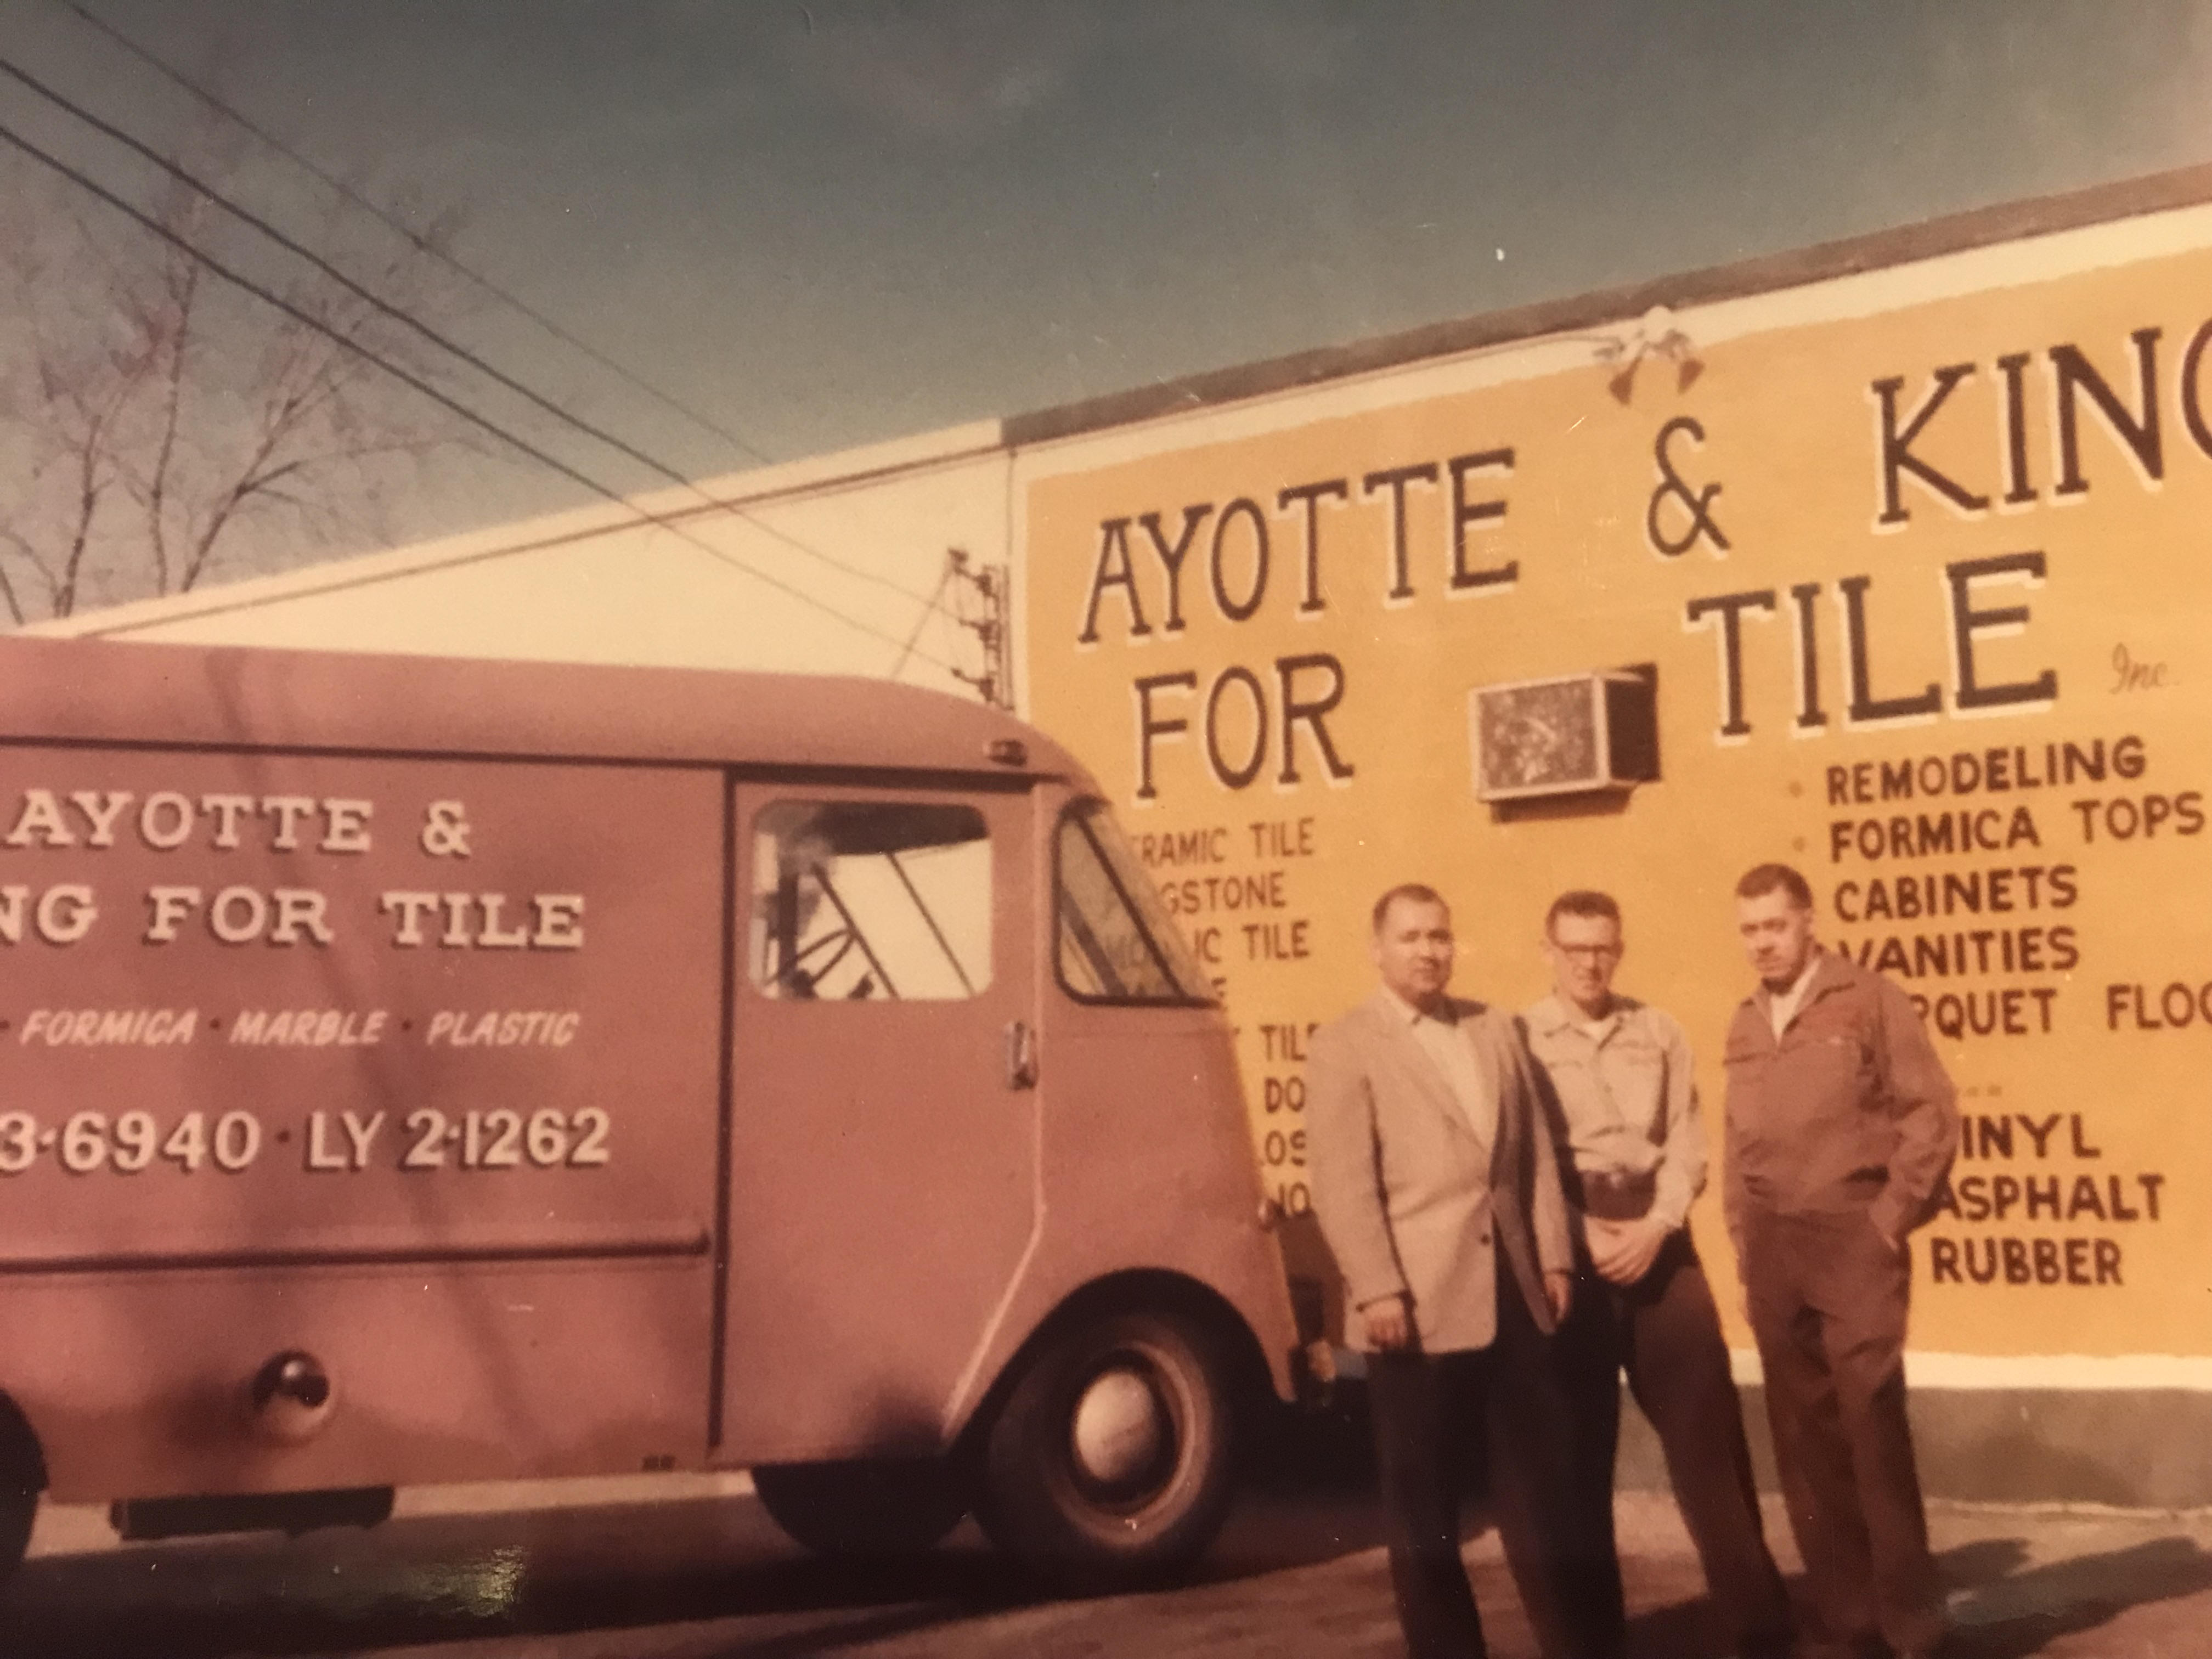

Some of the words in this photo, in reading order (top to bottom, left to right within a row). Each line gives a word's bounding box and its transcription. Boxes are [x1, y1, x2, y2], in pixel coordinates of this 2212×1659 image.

[1079, 447, 1519, 644] AYOTTE
[1646, 415, 1732, 557] &
[1134, 652, 1354, 799] FOR
[1686, 551, 2058, 737] TILE
[1826, 735, 2147, 805] REMODELING
[4, 788, 373, 852] AYOTTE
[420, 800, 472, 856] &
[1130, 827, 1228, 868] RAMIC
[1249, 817, 1314, 857] TILE
[1830, 804, 2042, 863] FORMICA
[2072, 792, 2206, 843] TOPS
[147, 885, 335, 944] FOR
[382, 890, 585, 948] TILE
[1833, 865, 2079, 923] CABINETS
[1242, 919, 1311, 961] TILE
[1838, 926, 2080, 979] VANITIES
[20, 1008, 199, 1046] FORMICA
[229, 1010, 388, 1046] MARBLE
[426, 1011, 582, 1047] PLASTIC
[308, 1110, 386, 1170] LY
[1932, 1173, 2165, 1222] ASPHALT
[1931, 1236, 2124, 1286] RUBBER
